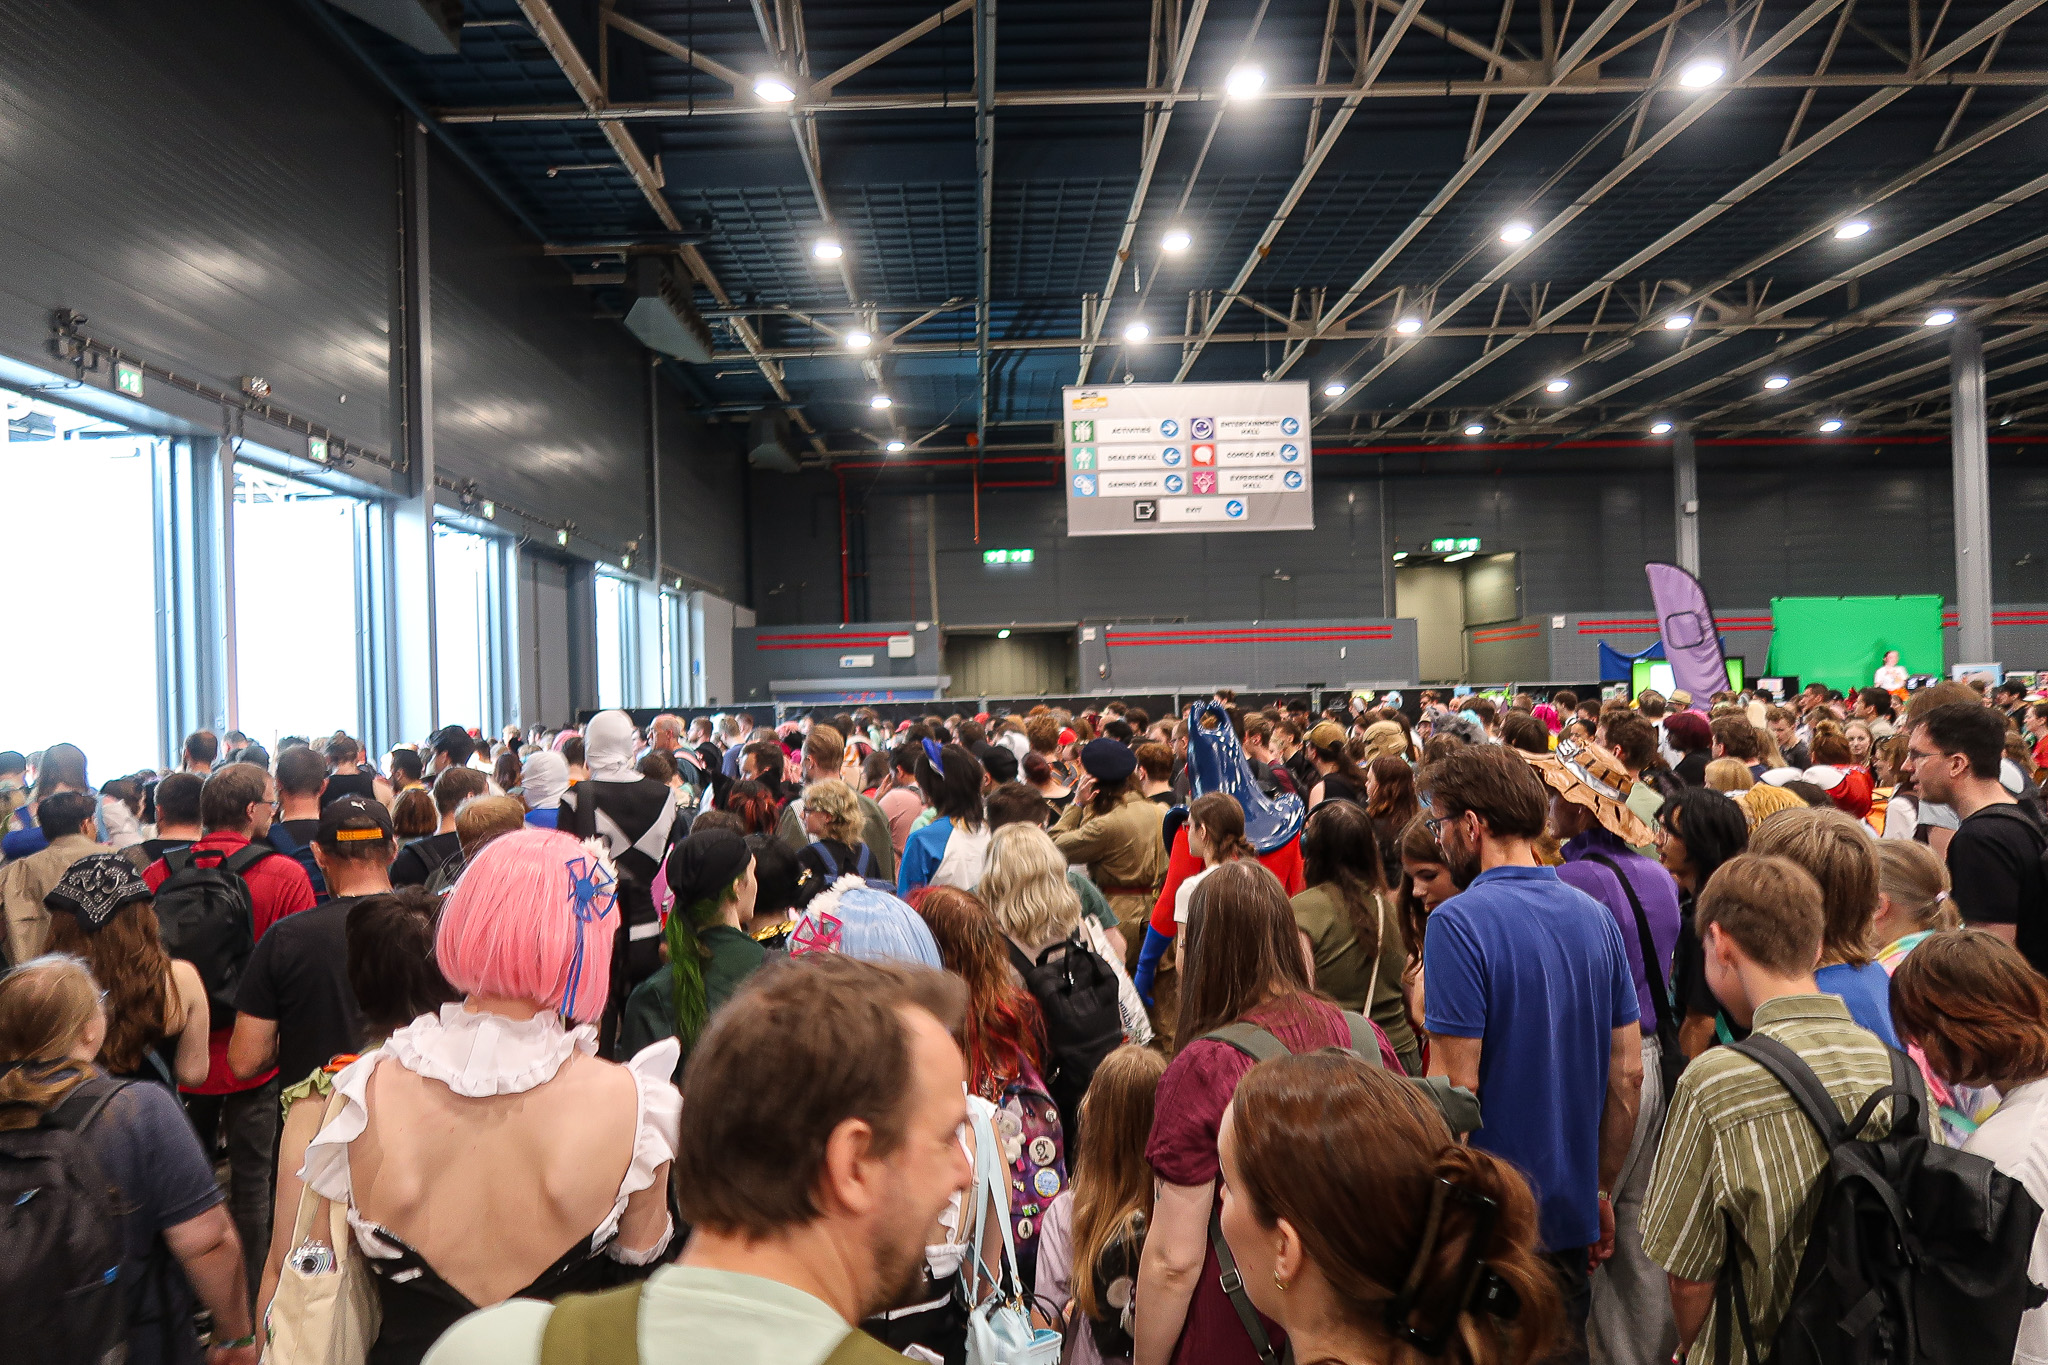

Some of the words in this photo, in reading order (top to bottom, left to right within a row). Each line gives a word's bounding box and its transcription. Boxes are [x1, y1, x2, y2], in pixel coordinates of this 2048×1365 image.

[1220, 420, 1279, 428] ENTERTAINMENT
[1112, 426, 1151, 435] ACTIVITIES
[1227, 451, 1253, 459] COMICS
[1255, 450, 1276, 458] AREA
[1107, 481, 1137, 489] GAMING
[1138, 480, 1158, 488] AREA
[1186, 506, 1203, 514] EXIT
